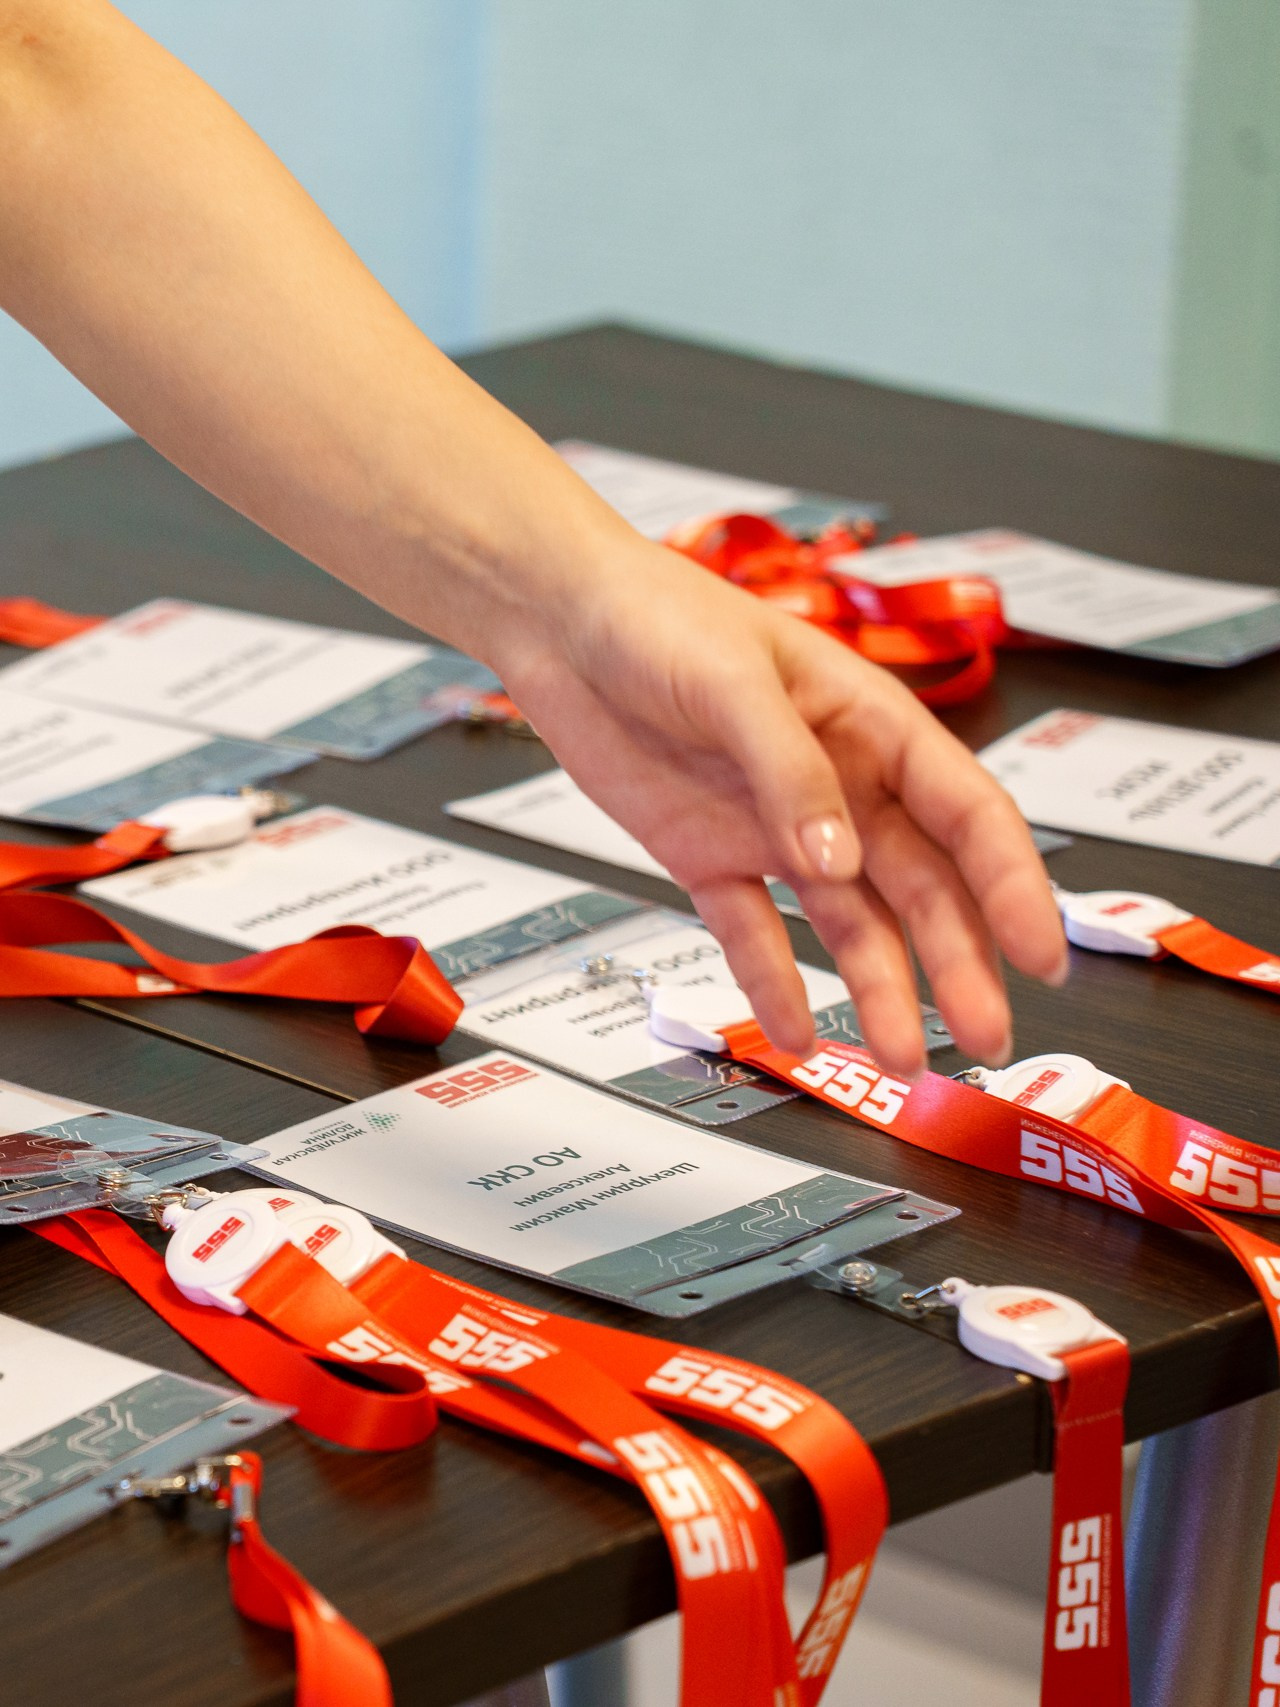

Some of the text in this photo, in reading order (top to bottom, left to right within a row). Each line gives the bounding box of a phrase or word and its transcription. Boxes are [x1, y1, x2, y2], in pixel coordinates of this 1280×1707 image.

[414, 1060, 531, 1105] 555
[790, 1051, 912, 1126] 555
[271, 1128, 367, 1166] ЖИГУЛЁВСКАЯ
[300, 1123, 355, 1145] ДОЛИНА
[466, 1146, 582, 1191] АО СКК
[513, 1163, 632, 1208] Алексеевич
[1020, 1129, 1146, 1215] 555
[1243, 1151, 1280, 1171] КОМП
[509, 1162, 701, 1232] Шехурдин Максим
[192, 1216, 243, 1262] 555
[428, 1312, 550, 1373] 555
[645, 1356, 806, 1430] 555
[613, 1431, 732, 1581] 555
[1054, 1515, 1101, 1652] 555
